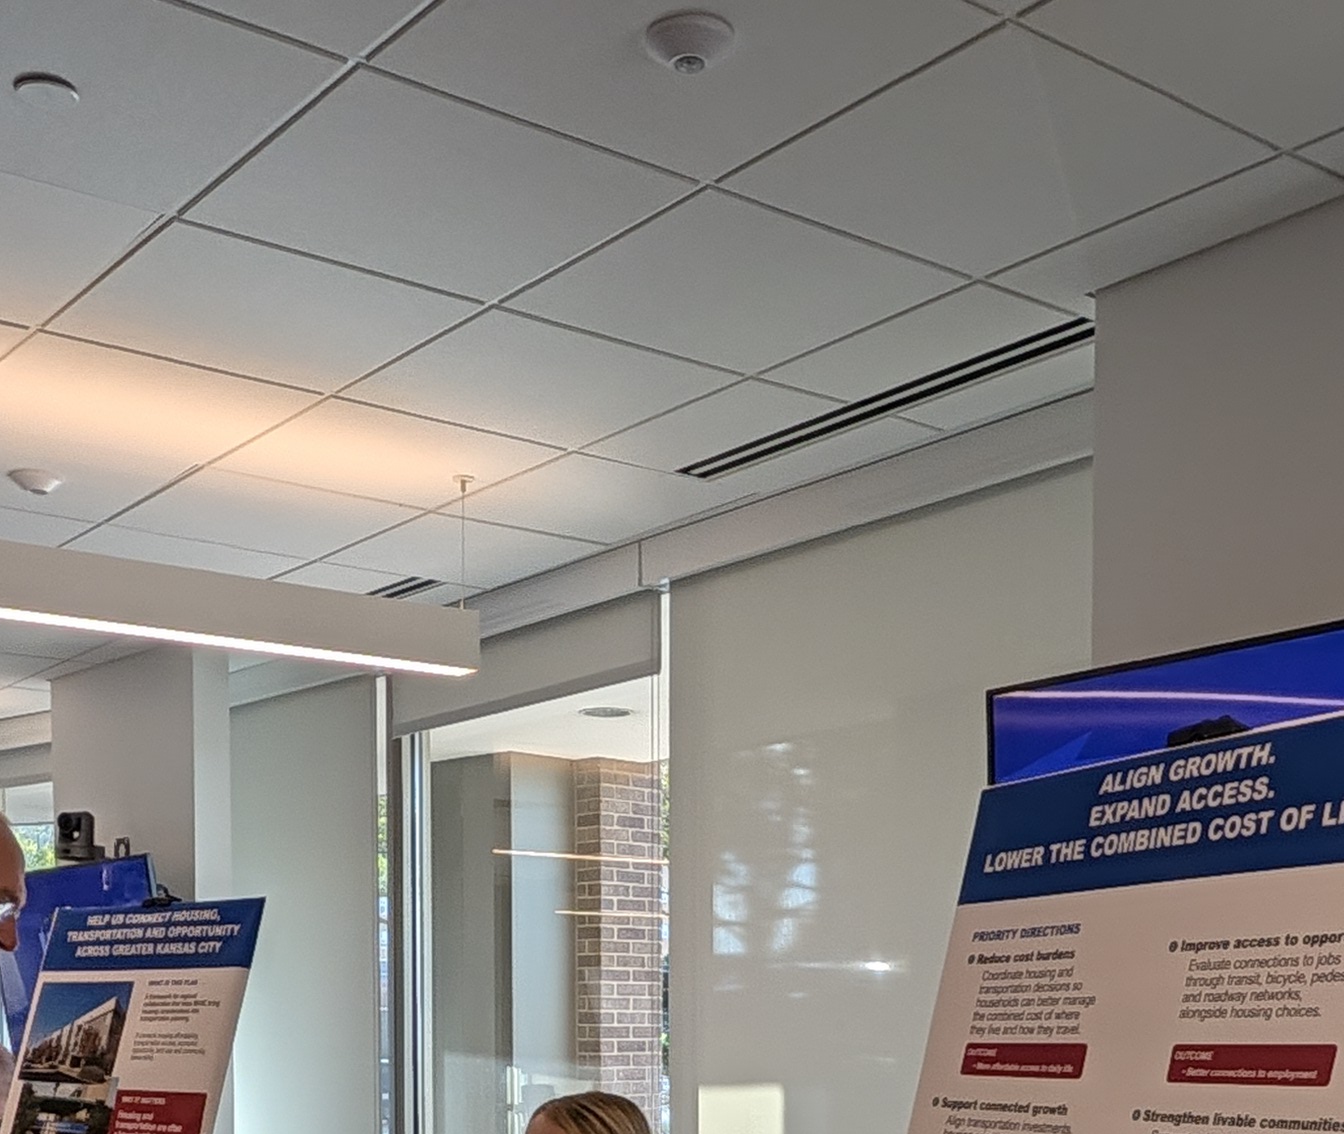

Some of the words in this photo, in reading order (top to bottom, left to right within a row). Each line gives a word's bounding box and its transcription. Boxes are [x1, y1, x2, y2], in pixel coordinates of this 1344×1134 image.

[1098, 763, 1164, 795] ALIGN
[1168, 743, 1275, 782] GROWTH.
[1087, 793, 1172, 828] EXPAND
[1174, 777, 1274, 813] ACCESS.
[983, 844, 1046, 875] LOWER
[1045, 838, 1086, 866] THE
[1088, 821, 1203, 860] COMBINED
[1205, 811, 1275, 843] COST
[1277, 804, 1316, 833] OF
[87, 915, 108, 926] HELP
[110, 914, 124, 925] US
[125, 912, 169, 924] CONNECT
[67, 928, 148, 941] TRANSPORTATION
[147, 927, 166, 938] AND
[167, 924, 240, 937] OPPORTUNITY
[972, 928, 1016, 942] PRIORITY
[1019, 923, 1082, 938] DIRECTIONS
[75, 945, 110, 956] ACROSS
[111, 943, 154, 955] GREATER
[155, 942, 196, 954] KANSAS
[197, 941, 222, 952] CITY
[1181, 940, 1229, 952] Improve
[1233, 937, 1280, 948] access
[1284, 934, 1298, 945] to
[977, 953, 1010, 964] Reduce
[1013, 951, 1034, 962] cost
[1035, 949, 1076, 960] burdens
[941, 1097, 978, 1111] Support
[979, 1101, 1030, 1113] connected
[1031, 1104, 1069, 1116] growth
[1143, 1109, 1209, 1125] Strengthen
[1212, 1113, 1255, 1127] livable
